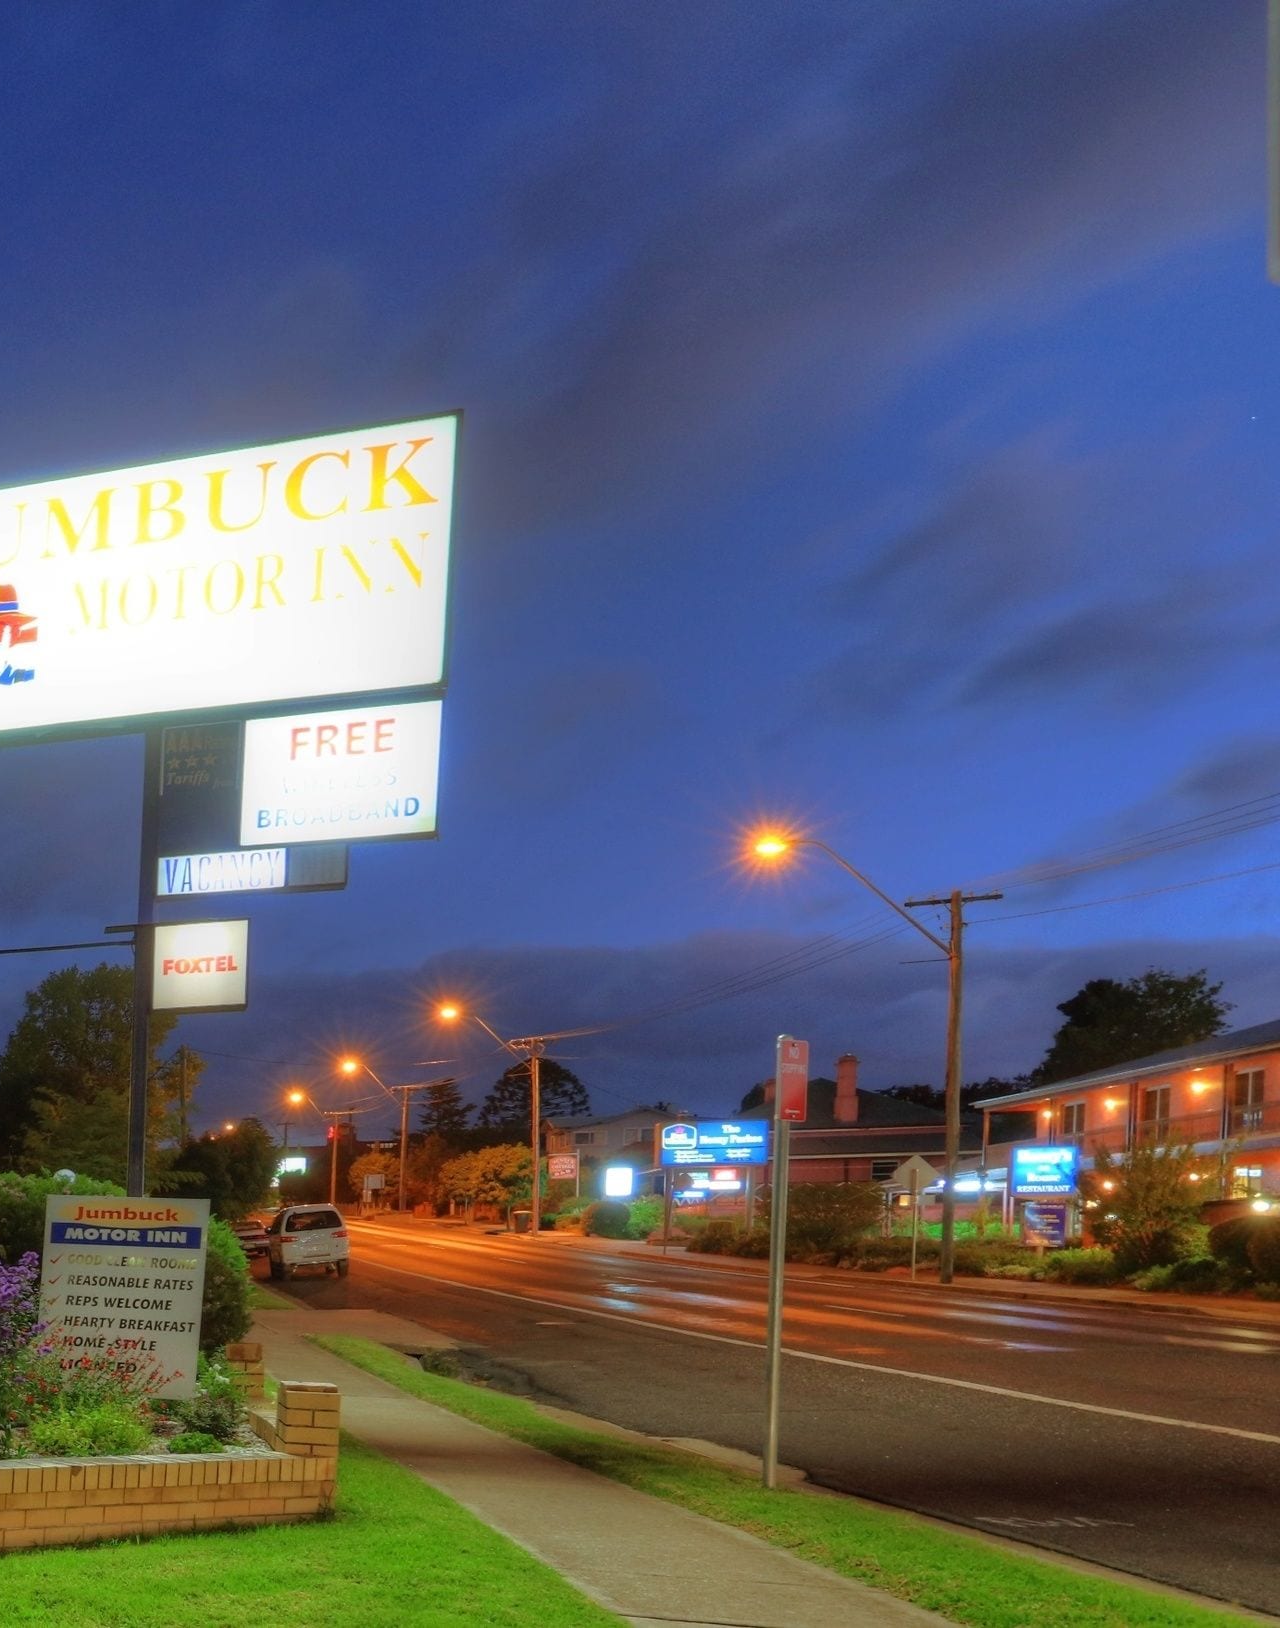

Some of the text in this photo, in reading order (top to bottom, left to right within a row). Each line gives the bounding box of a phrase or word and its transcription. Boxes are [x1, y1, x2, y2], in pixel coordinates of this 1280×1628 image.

[68, 532, 431, 635] MOTOR INN
[290, 718, 396, 761] FREE
[166, 770, 210, 786] Tariffs
[256, 797, 420, 828] BROADBAND
[164, 850, 280, 893] VACANCY
[163, 955, 238, 976] FOXTEL
[1016, 1184, 1072, 1193] RESTAURANT
[73, 1206, 179, 1222] Jumbuck
[64, 1227, 188, 1244] MOTOR INN
[67, 1274, 194, 1291] REASONABLE RATES
[65, 1295, 173, 1311] REPS WELCOME
[63, 1316, 196, 1333] HEARTY BREAKFAST
